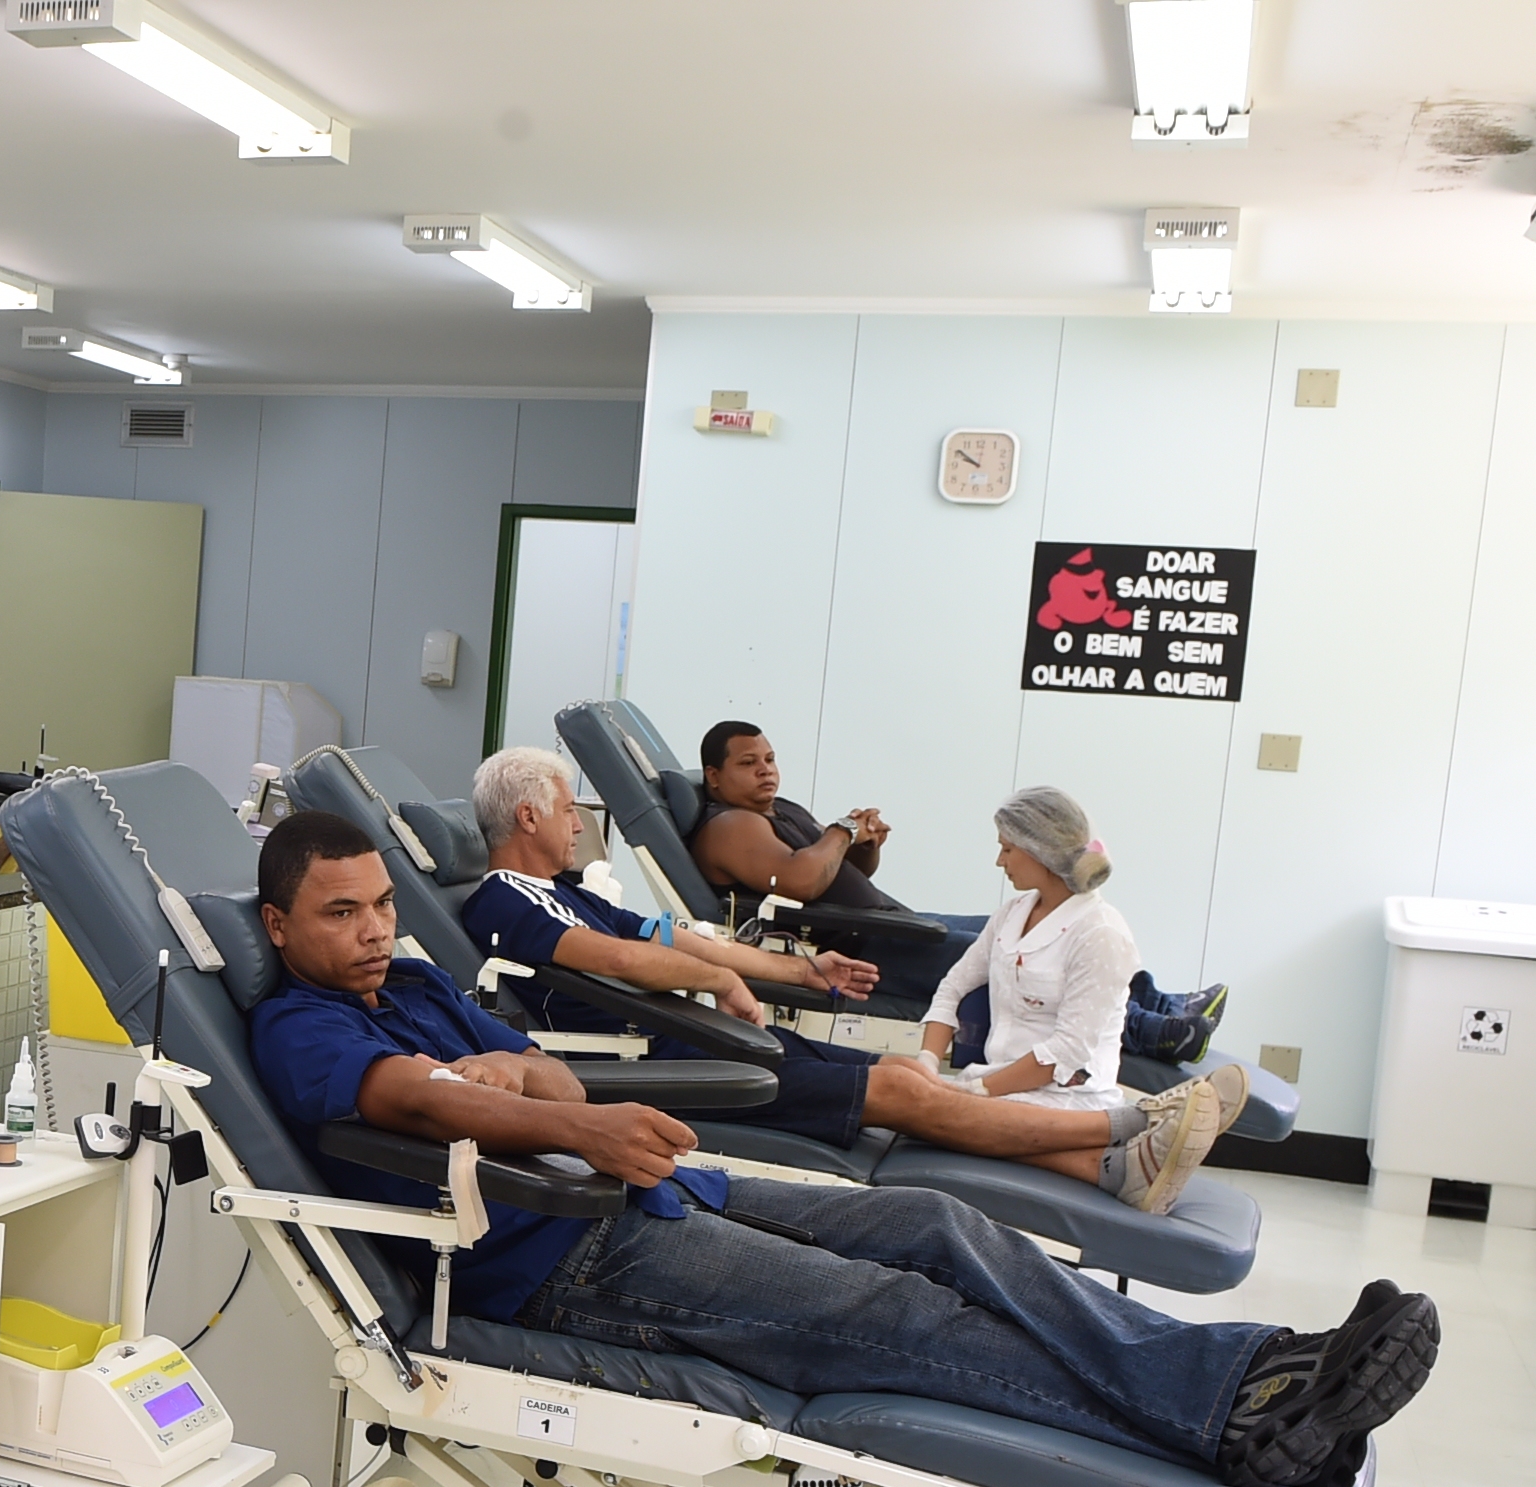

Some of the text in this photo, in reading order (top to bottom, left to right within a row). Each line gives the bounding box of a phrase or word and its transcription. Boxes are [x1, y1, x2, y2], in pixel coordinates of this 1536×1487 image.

[723, 413, 751, 427] SAÍDA
[1146, 551, 1216, 574] DOAR
[1116, 576, 1229, 604] SANGUE
[1132, 605, 1239, 635] É FAZER
[1053, 631, 1224, 665] O BEM SEM
[1031, 664, 1228, 697] OLHAR A QUEM
[846, 1027, 852, 1035] 1
[526, 1400, 570, 1416] CADEIRA
[540, 1419, 550, 1434] 1
